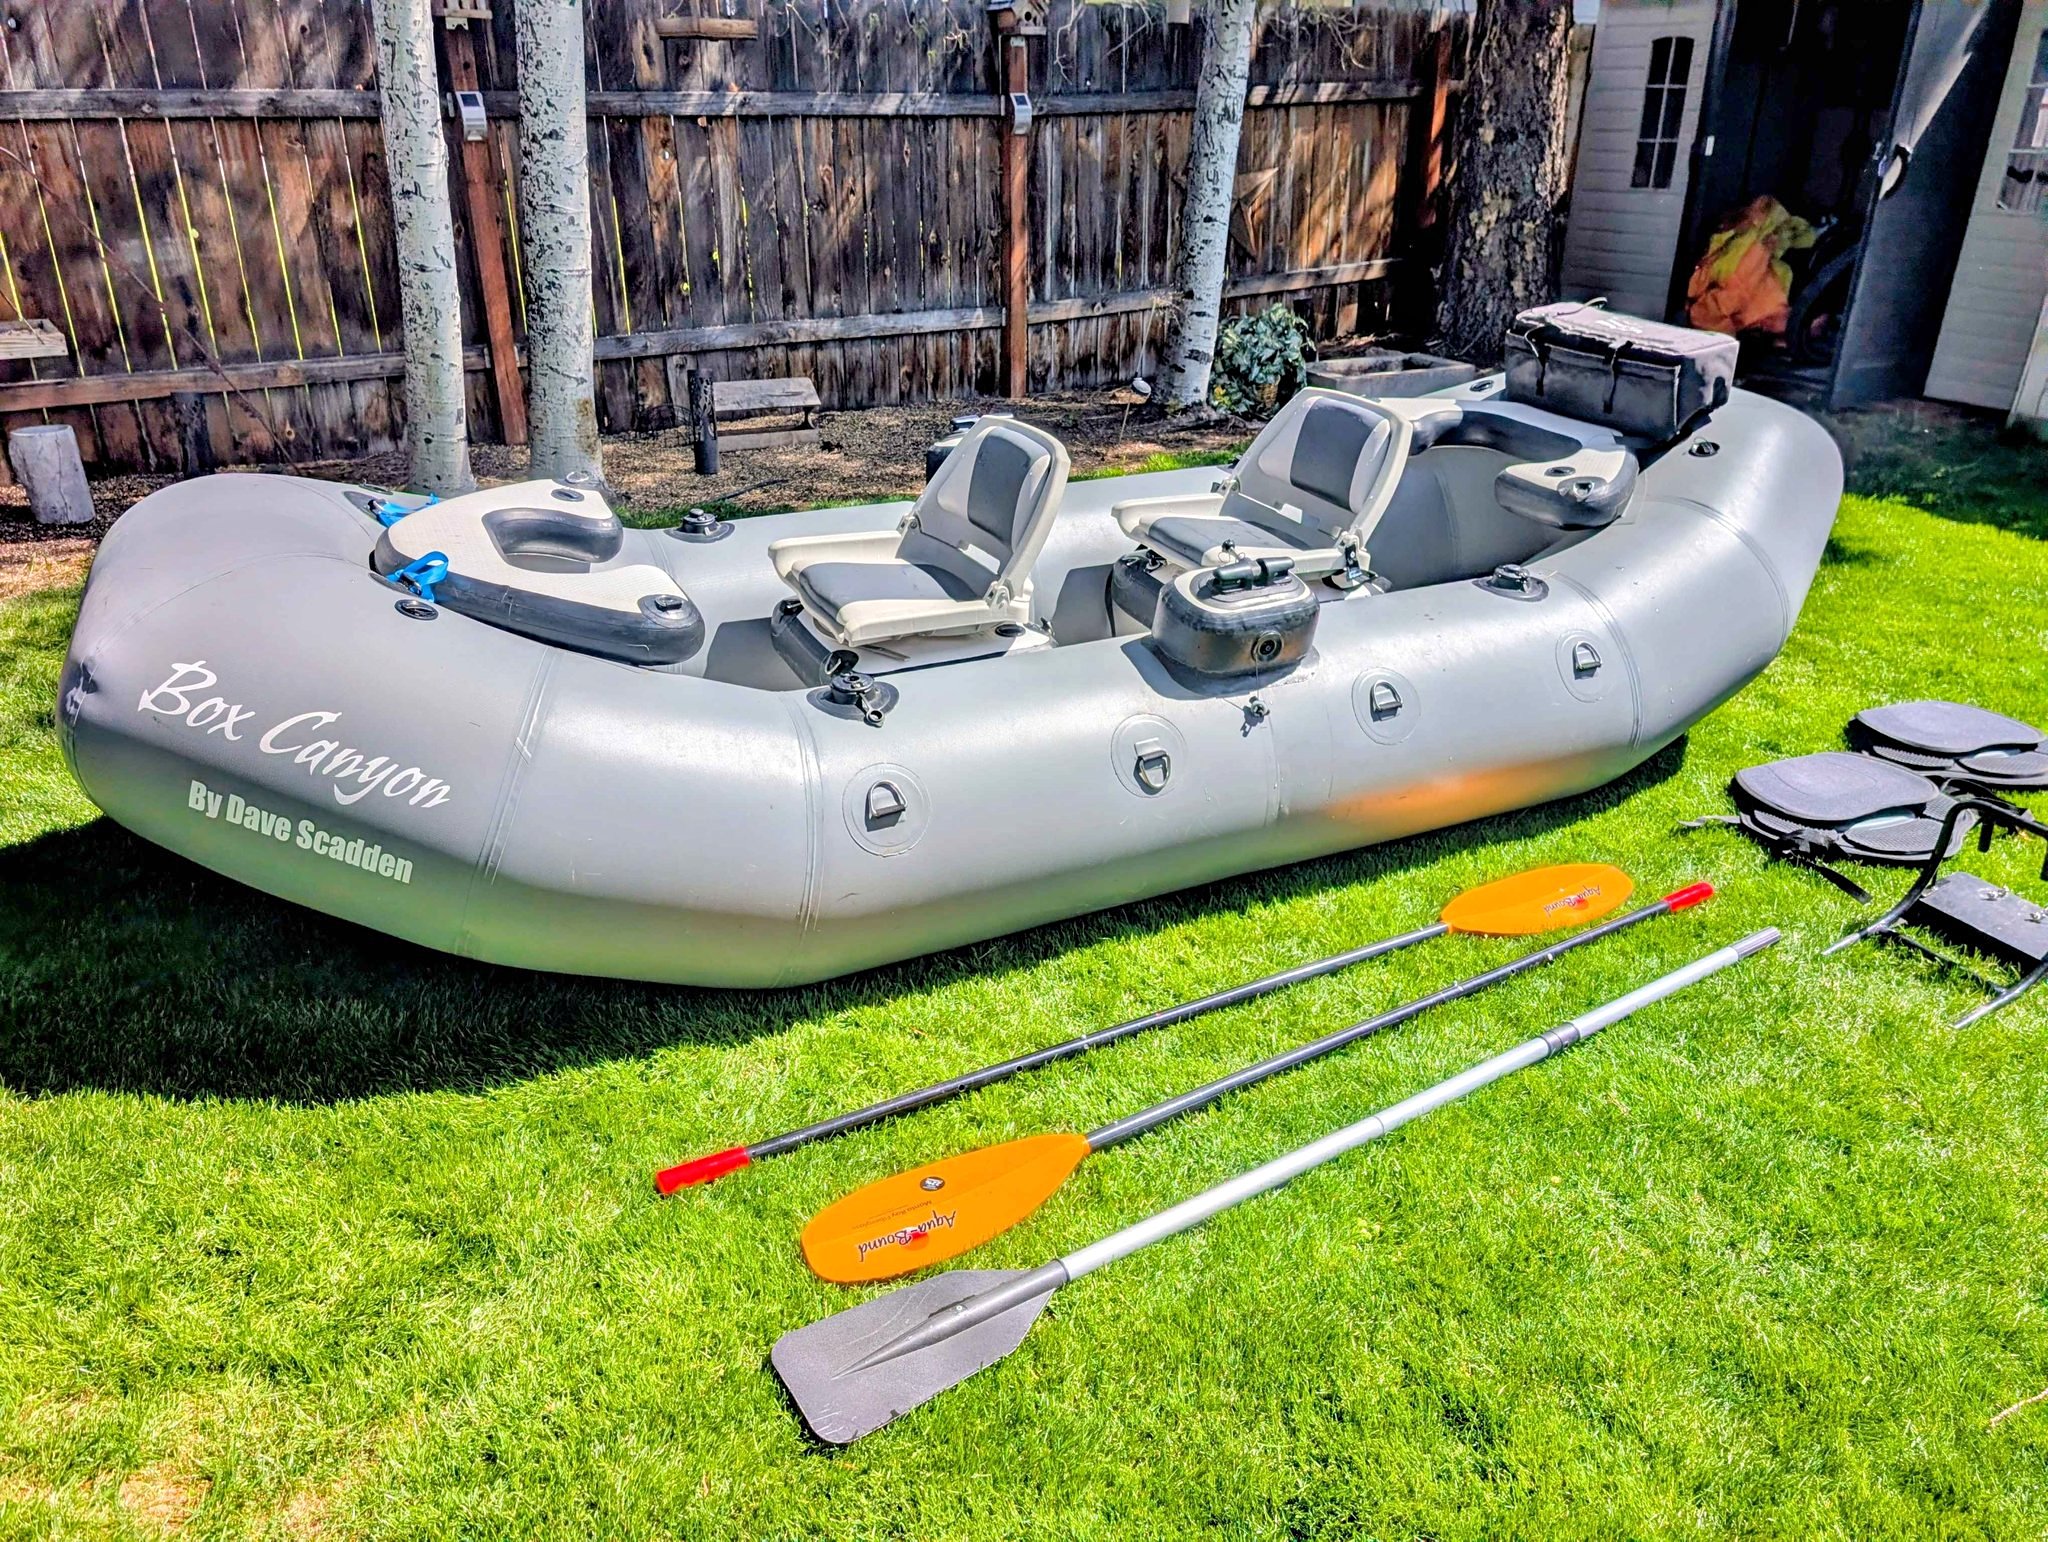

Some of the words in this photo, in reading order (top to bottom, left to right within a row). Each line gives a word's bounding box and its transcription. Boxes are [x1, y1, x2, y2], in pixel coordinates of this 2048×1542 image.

[138, 660, 255, 741] Box
[259, 711, 450, 808] Canyon
[188, 780, 223, 819] By
[226, 794, 292, 842] Dave
[296, 819, 413, 884] Scadden
